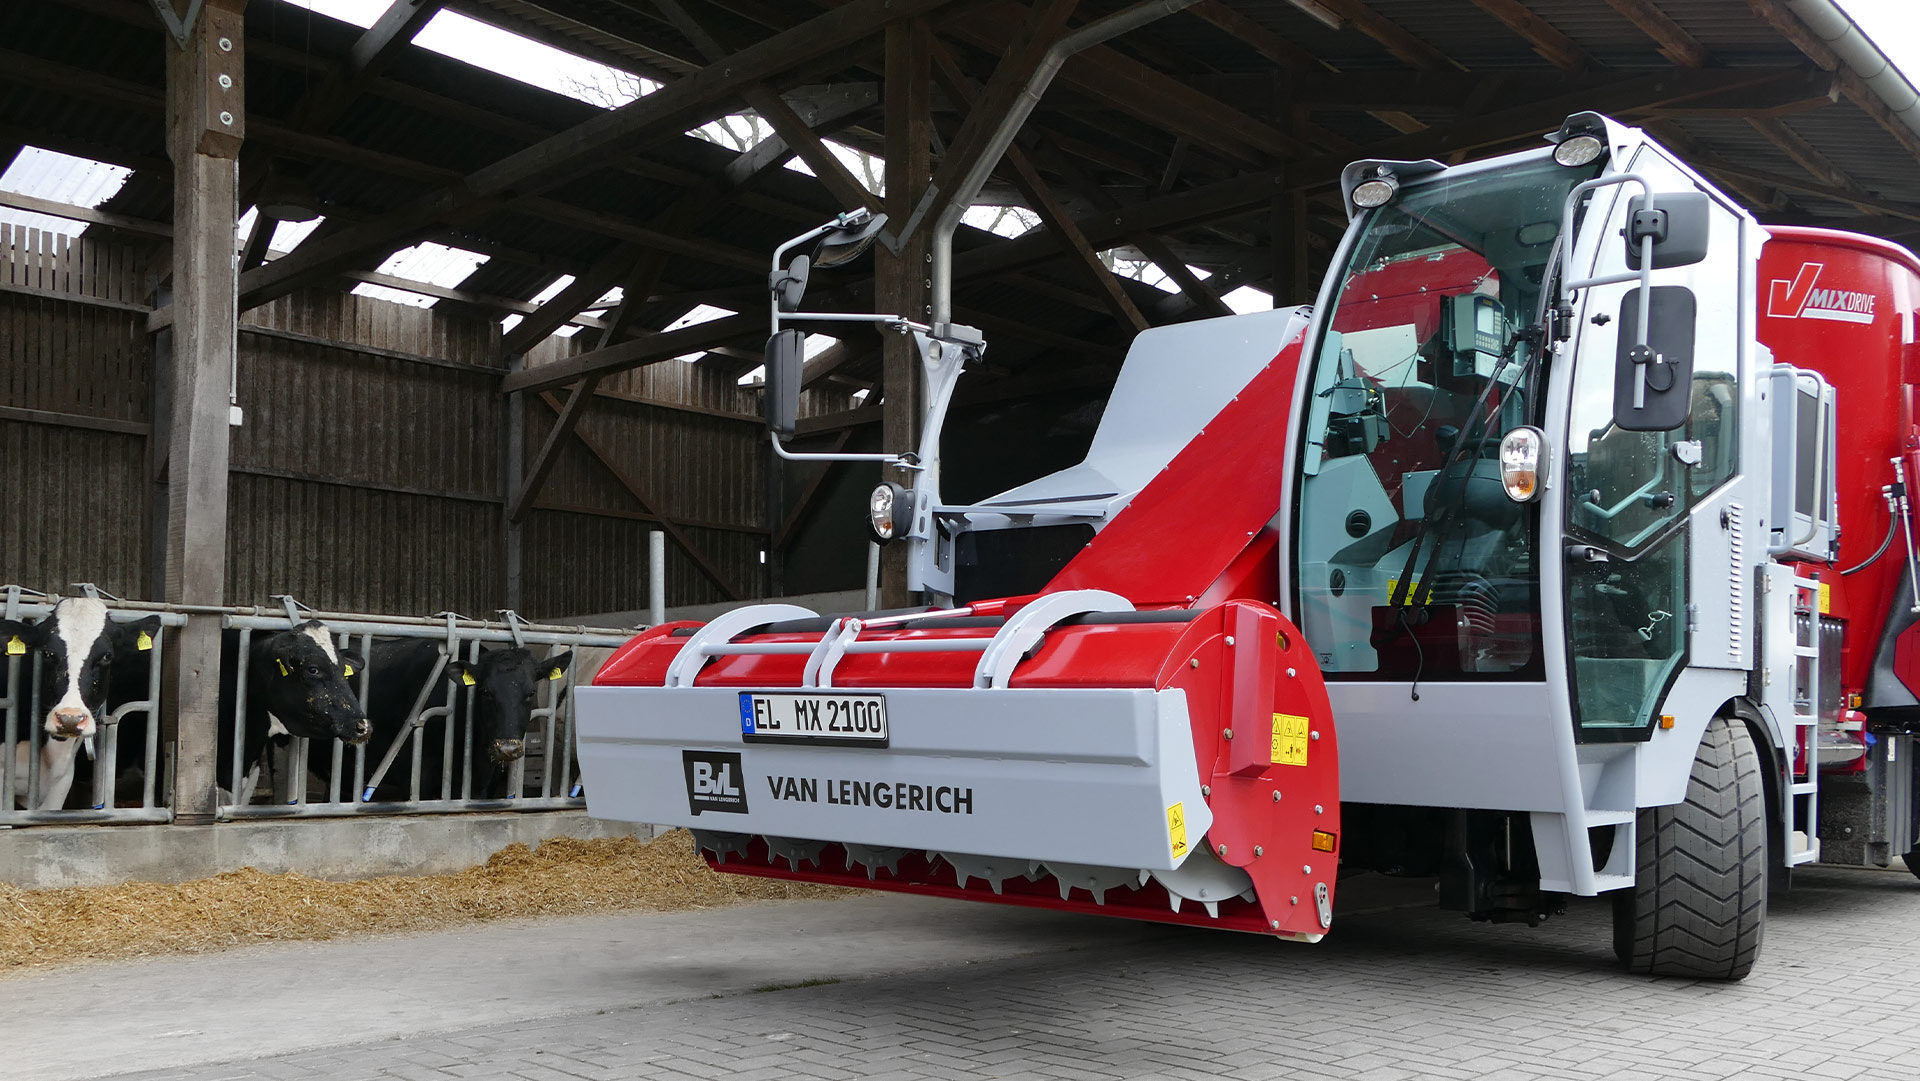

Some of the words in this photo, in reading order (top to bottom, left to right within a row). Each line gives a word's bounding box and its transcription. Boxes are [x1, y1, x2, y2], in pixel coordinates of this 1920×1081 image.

[745, 717, 752, 727] D
[754, 699, 781, 729] EL
[795, 700, 823, 731] MX
[827, 700, 882, 732] 2100
[767, 775, 818, 803] VAN
[827, 780, 973, 814] LENGERICH
